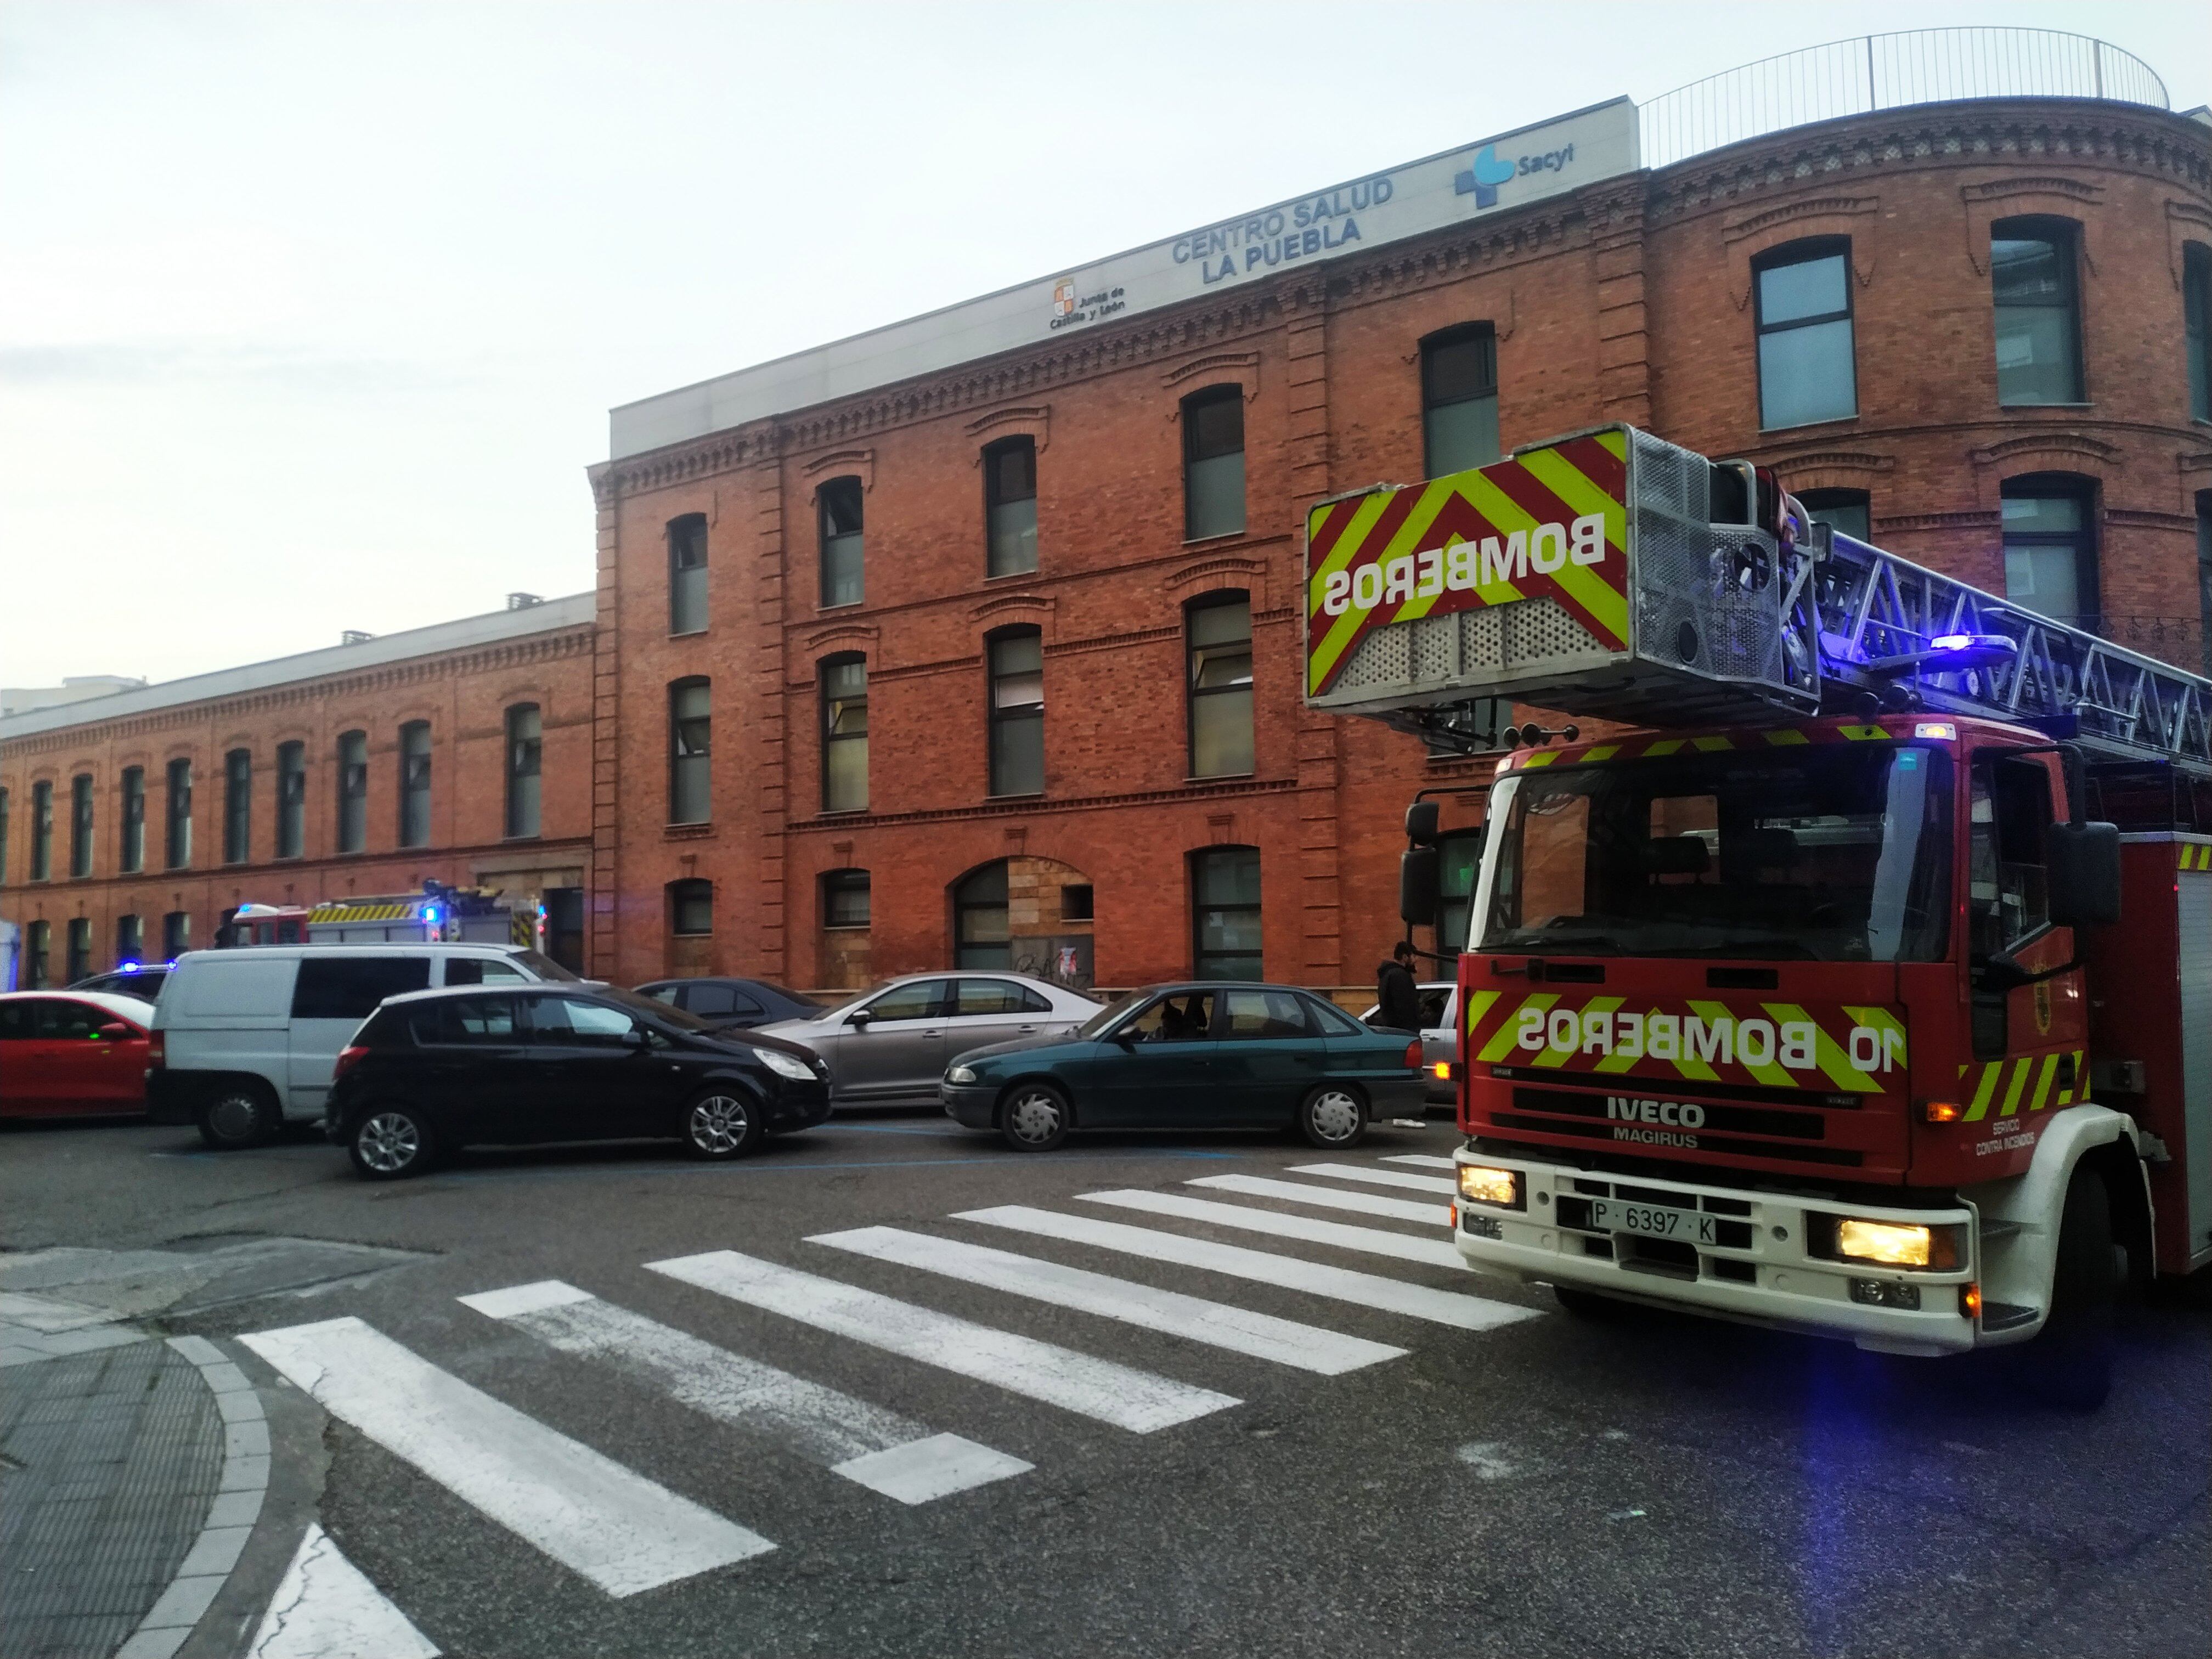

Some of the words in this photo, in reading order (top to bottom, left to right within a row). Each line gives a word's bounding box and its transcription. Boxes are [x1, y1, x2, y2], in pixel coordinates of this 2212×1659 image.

[1518, 143, 1574, 176] Sacyl
[1172, 211, 1285, 263] CENTRO
[1293, 177, 1393, 228] SALUD
[1202, 254, 1237, 285] LA
[1245, 217, 1361, 272] PUEBLA
[1111, 287, 1124, 298] de
[1089, 309, 1096, 320] y
[1607, 1096, 1706, 1128] IVECO
[1613, 1126, 1699, 1148] MAGIRUS
[1595, 1202, 1607, 1223] P
[1626, 1207, 1679, 1235] 6397
[1700, 1217, 1712, 1242] K
